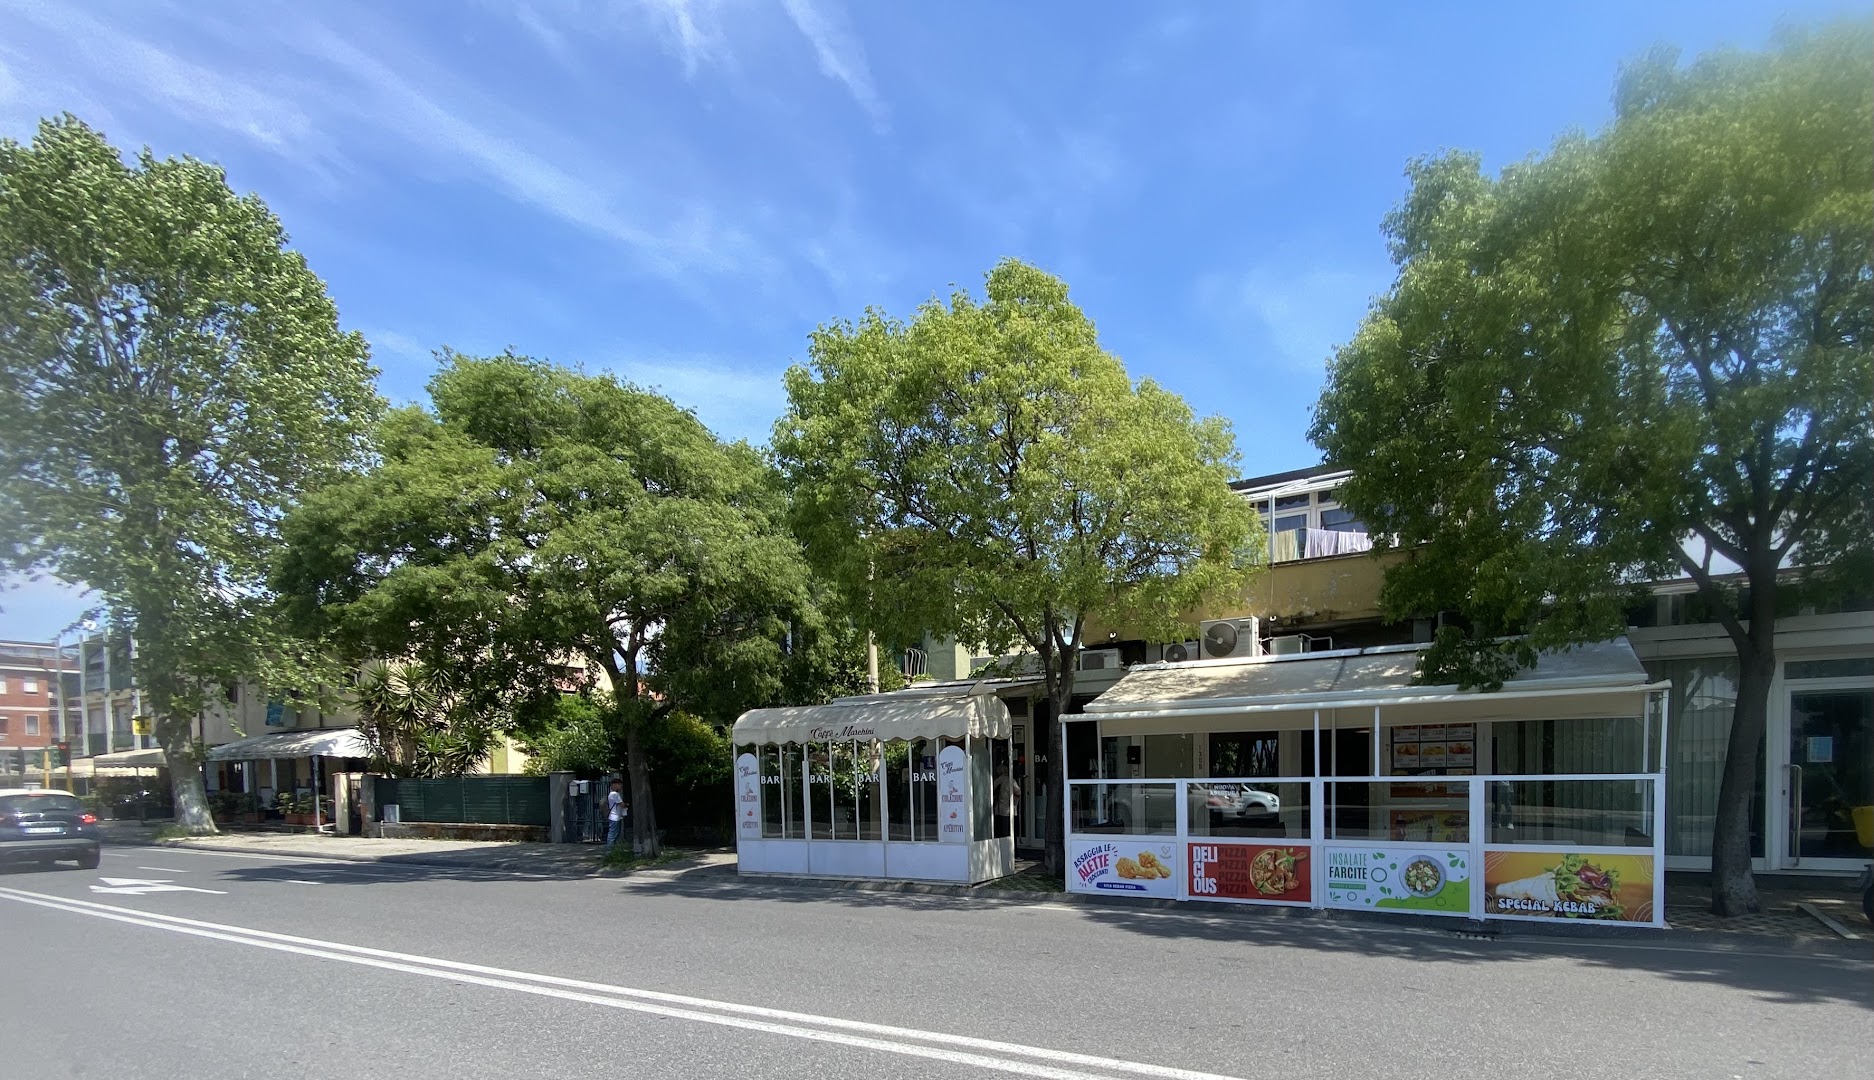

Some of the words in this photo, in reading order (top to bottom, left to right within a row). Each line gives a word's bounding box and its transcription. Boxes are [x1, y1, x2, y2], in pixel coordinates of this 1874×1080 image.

[811, 727, 834, 740] Caffè
[836, 725, 875, 738] Marchini
[1034, 754, 1048, 763] BA
[761, 775, 780, 785] BAR
[810, 775, 830, 784] BAR
[858, 774, 880, 783] BAR
[912, 772, 936, 782] BAR
[1073, 845, 1102, 868] ASSAGGIA
[1104, 843, 1111, 852] LE
[1192, 846, 1217, 863] DELI
[1218, 847, 1247, 858] PIZZA
[1329, 852, 1367, 866] INSALATE
[1078, 853, 1110, 882] ALETTE
[1193, 862, 1205, 878] CI
[1218, 860, 1247, 870] PIZZA
[1087, 868, 1109, 884] CROCCANTI
[1218, 871, 1248, 882] PIZZA
[1329, 866, 1367, 880] FARCITE
[1193, 878, 1217, 894] OUS
[1218, 883, 1248, 894] PIZZA
[1497, 898, 1551, 912] SPECIAL
[1552, 900, 1597, 914] KEBAB
